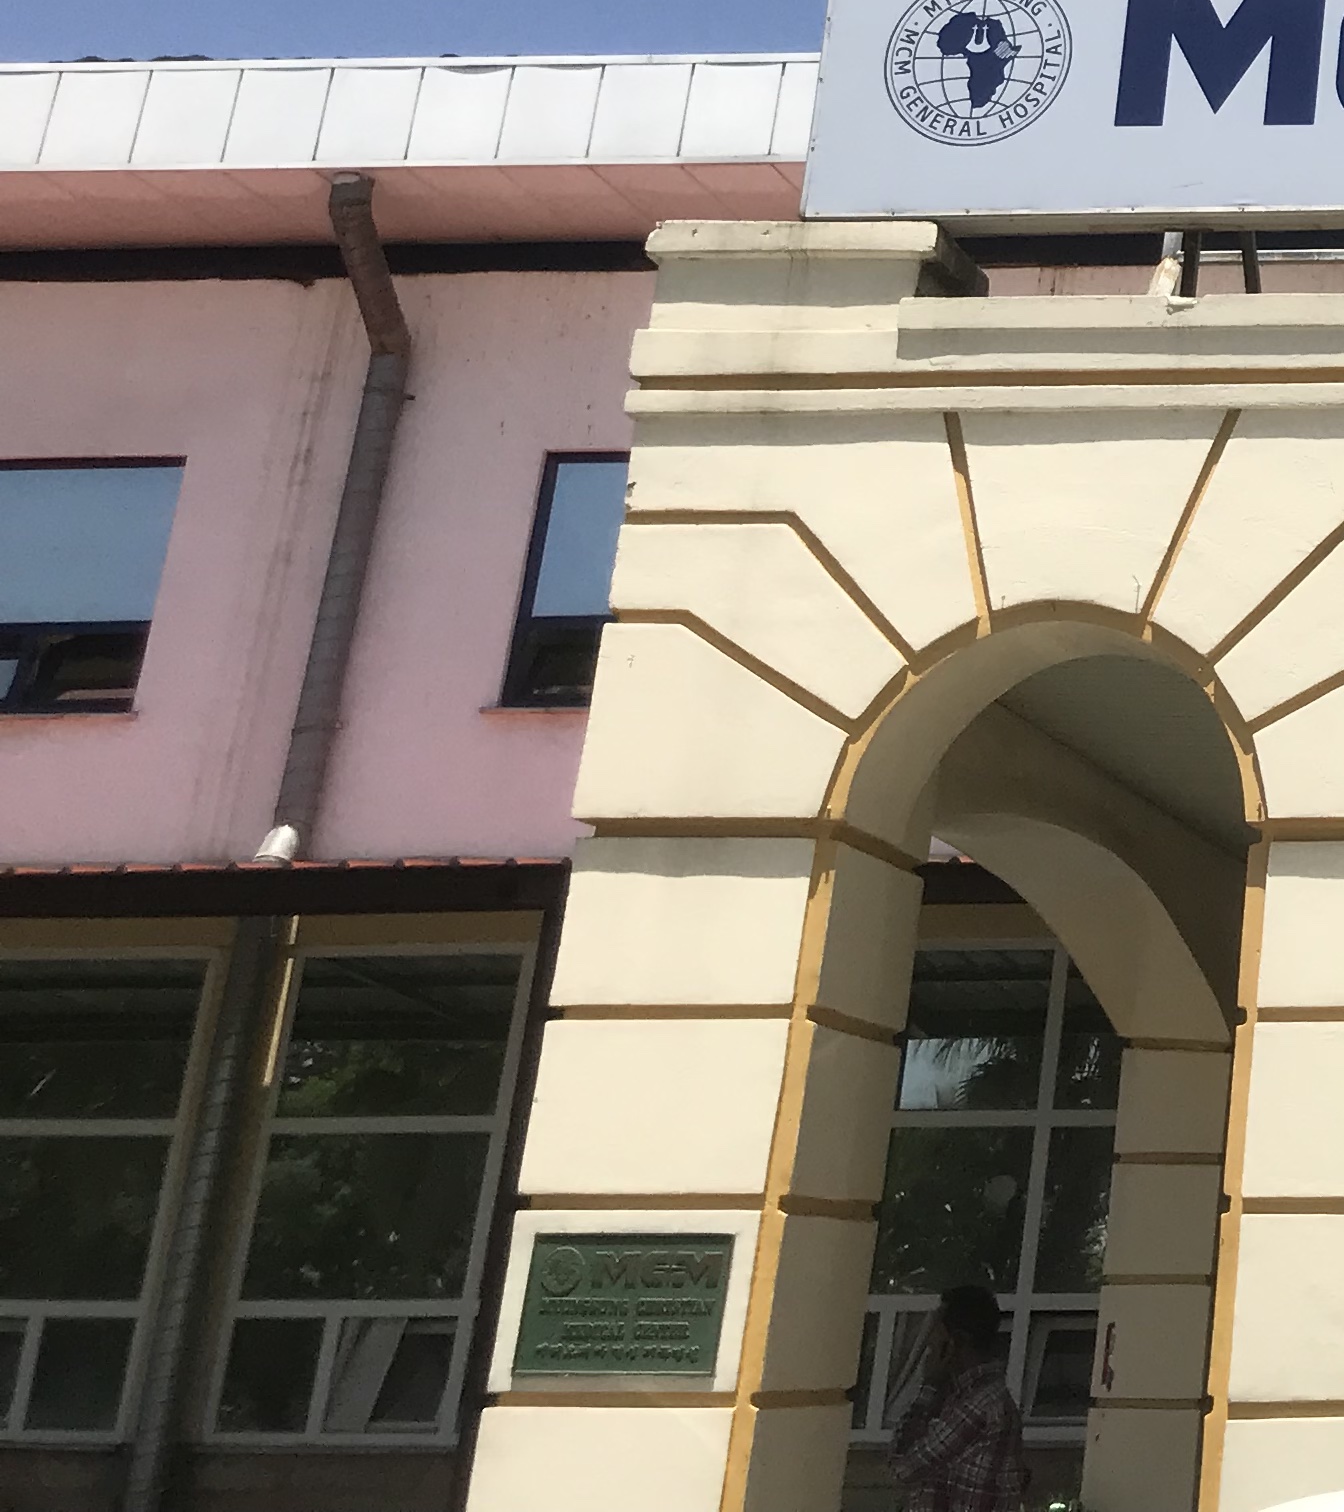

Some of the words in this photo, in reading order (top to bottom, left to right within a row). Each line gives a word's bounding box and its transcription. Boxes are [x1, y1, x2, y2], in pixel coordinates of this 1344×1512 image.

[894, 28, 920, 76] MCM
[998, 29, 1063, 129] HOSPITAL
[900, 85, 988, 137] GENERAL
